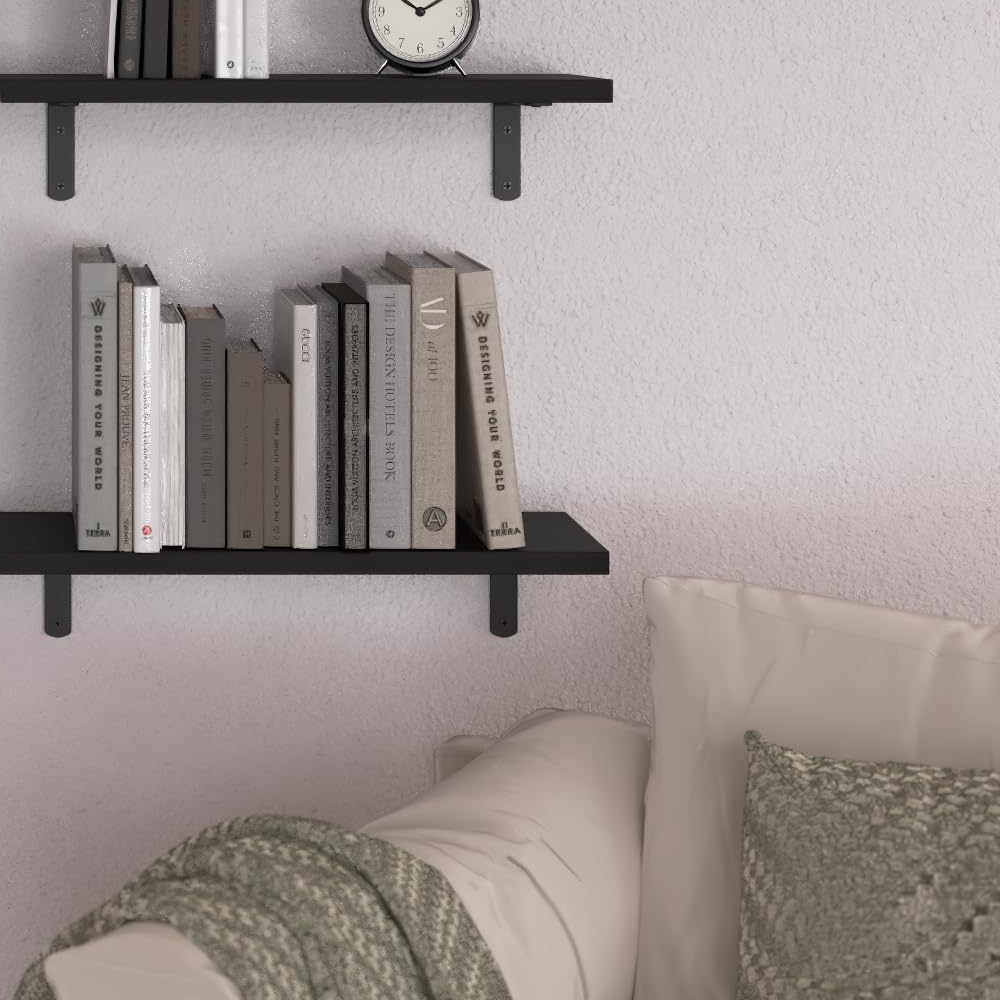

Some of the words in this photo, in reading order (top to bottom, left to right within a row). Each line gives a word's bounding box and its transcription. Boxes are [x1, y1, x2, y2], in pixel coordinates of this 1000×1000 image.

[378, 6, 385, 17] 9
[455, 6, 463, 18] 3
[383, 24, 391, 35] 8
[398, 37, 406, 49] 7
[436, 37, 445, 48] 5
[449, 25, 456, 36] 4
[416, 42, 424, 54] 6
[384, 293, 396, 323] THE
[93, 325, 103, 398] DESIGNING
[384, 326, 396, 378] DESIGN
[478, 336, 495, 404] DESIGNING
[94, 403, 103, 438] YOUR
[384, 381, 396, 437] HOTELS
[487, 409, 500, 442] YOUR
[94, 446, 103, 491] WORLD
[384, 442, 396, 481] BOOK
[492, 449, 505, 492] WORLD
